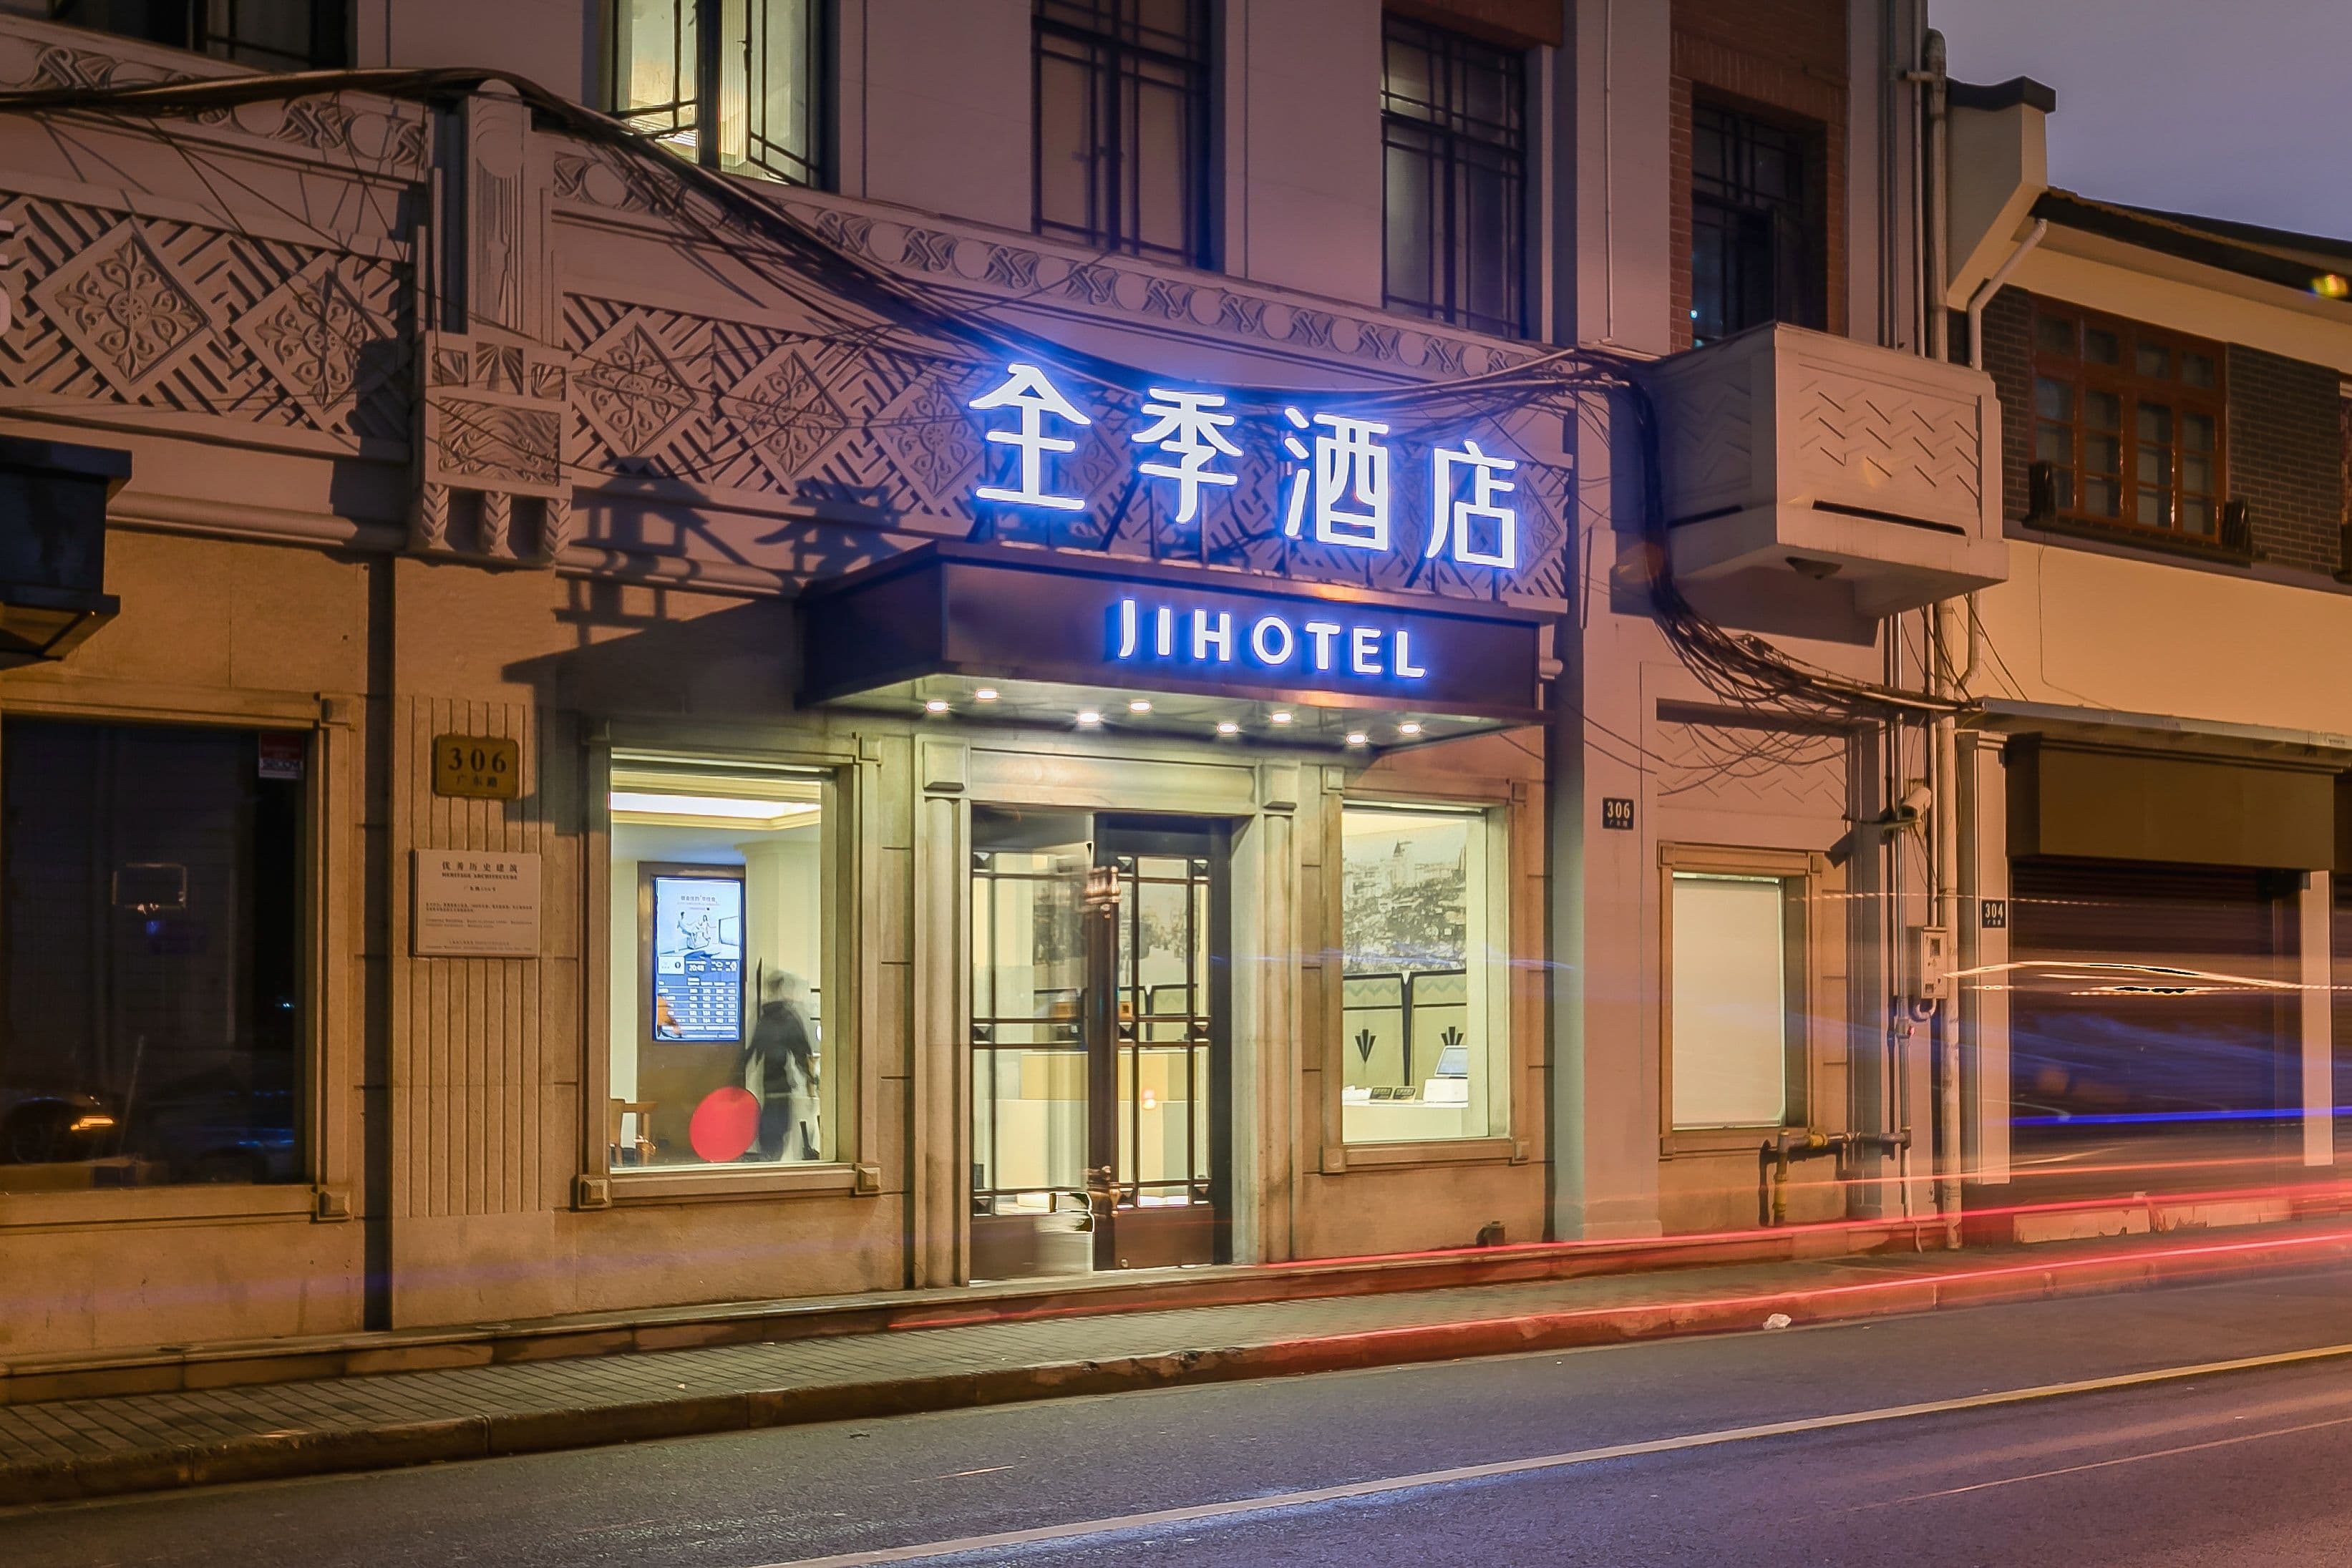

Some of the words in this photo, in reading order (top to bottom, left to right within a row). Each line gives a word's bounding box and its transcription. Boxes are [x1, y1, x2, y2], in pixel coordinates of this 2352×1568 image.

[968, 363, 1518, 570] 全季酒店
[448, 746, 507, 774] 306
[1607, 802, 1630, 819] 306
[1985, 902, 2003, 919] 304
